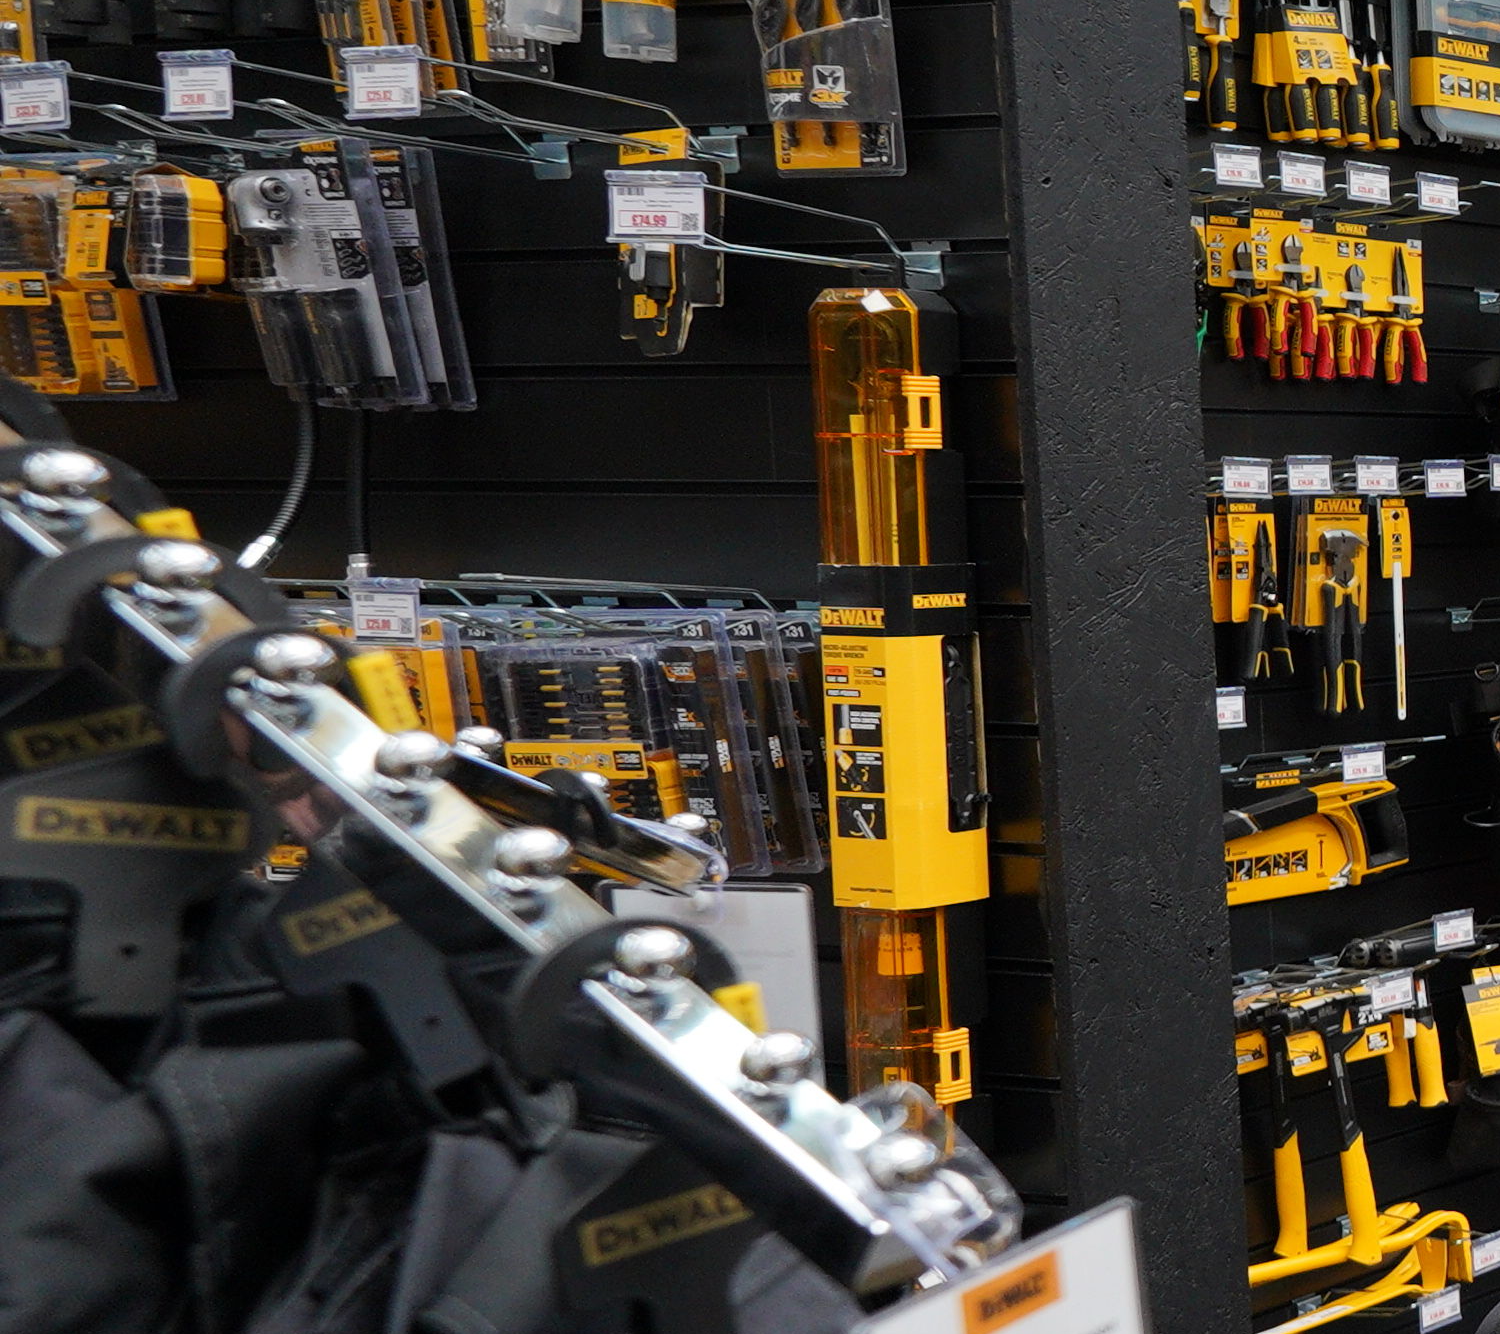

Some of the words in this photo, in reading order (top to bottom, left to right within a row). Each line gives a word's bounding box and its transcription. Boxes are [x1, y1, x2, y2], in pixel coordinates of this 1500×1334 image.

[1286, 9, 1338, 29] DEWALT
[1438, 37, 1489, 61] DEWALT
[631, 212, 668, 228] £74.99
[1253, 208, 1284, 220] DEWALT
[1335, 222, 1368, 236] DEWALT
[1315, 499, 1361, 513] DEWALT
[912, 593, 967, 610] DEWALT
[820, 608, 885, 629] DEWALT
[682, 623, 704, 639] x31
[732, 623, 755, 638] x31
[510, 753, 552, 769] DEWALT
